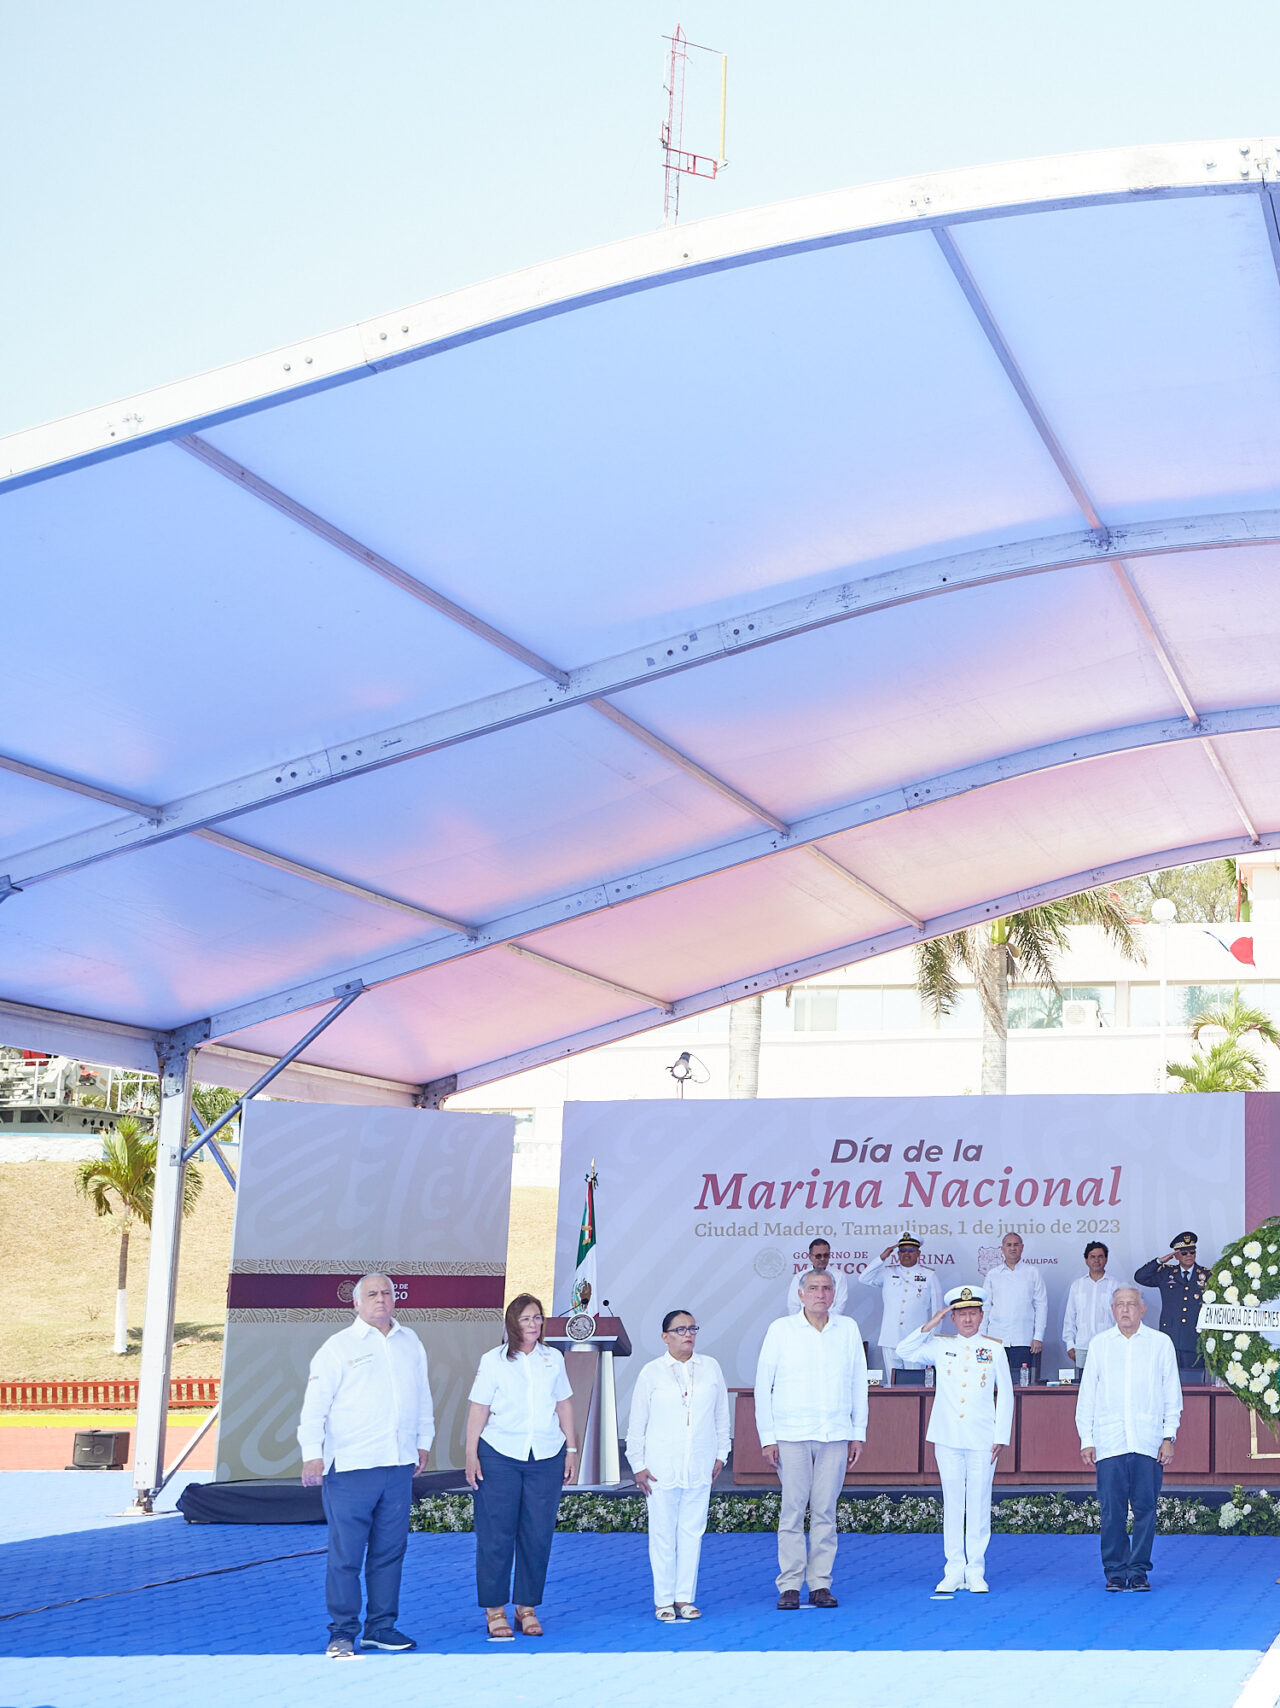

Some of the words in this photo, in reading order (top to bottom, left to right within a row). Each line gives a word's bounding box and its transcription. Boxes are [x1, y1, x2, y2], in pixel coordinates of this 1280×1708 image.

[830, 1136, 893, 1164] Día
[903, 1139, 943, 1163] de
[953, 1138, 983, 1162] la
[693, 1167, 884, 1210] Marina
[898, 1165, 1122, 1208] Nacional
[694, 1221, 759, 1237] Ciudad
[764, 1220, 837, 1238] Madero,
[841, 1219, 953, 1236] Tamaulipas,
[958, 1220, 968, 1235] 1
[972, 1219, 994, 1234] de
[997, 1218, 1046, 1238] junio
[1050, 1218, 1072, 1233] de
[1076, 1218, 1121, 1234] 2023
[792, 1251, 851, 1260] GORNO
[854, 1251, 869, 1259] DE
[1205, 1307, 1213, 1324] EN
[1213, 1308, 1242, 1326] MEMORIA
[1243, 1309, 1251, 1326] DE
[1253, 1310, 1279, 1328] QUIENES
